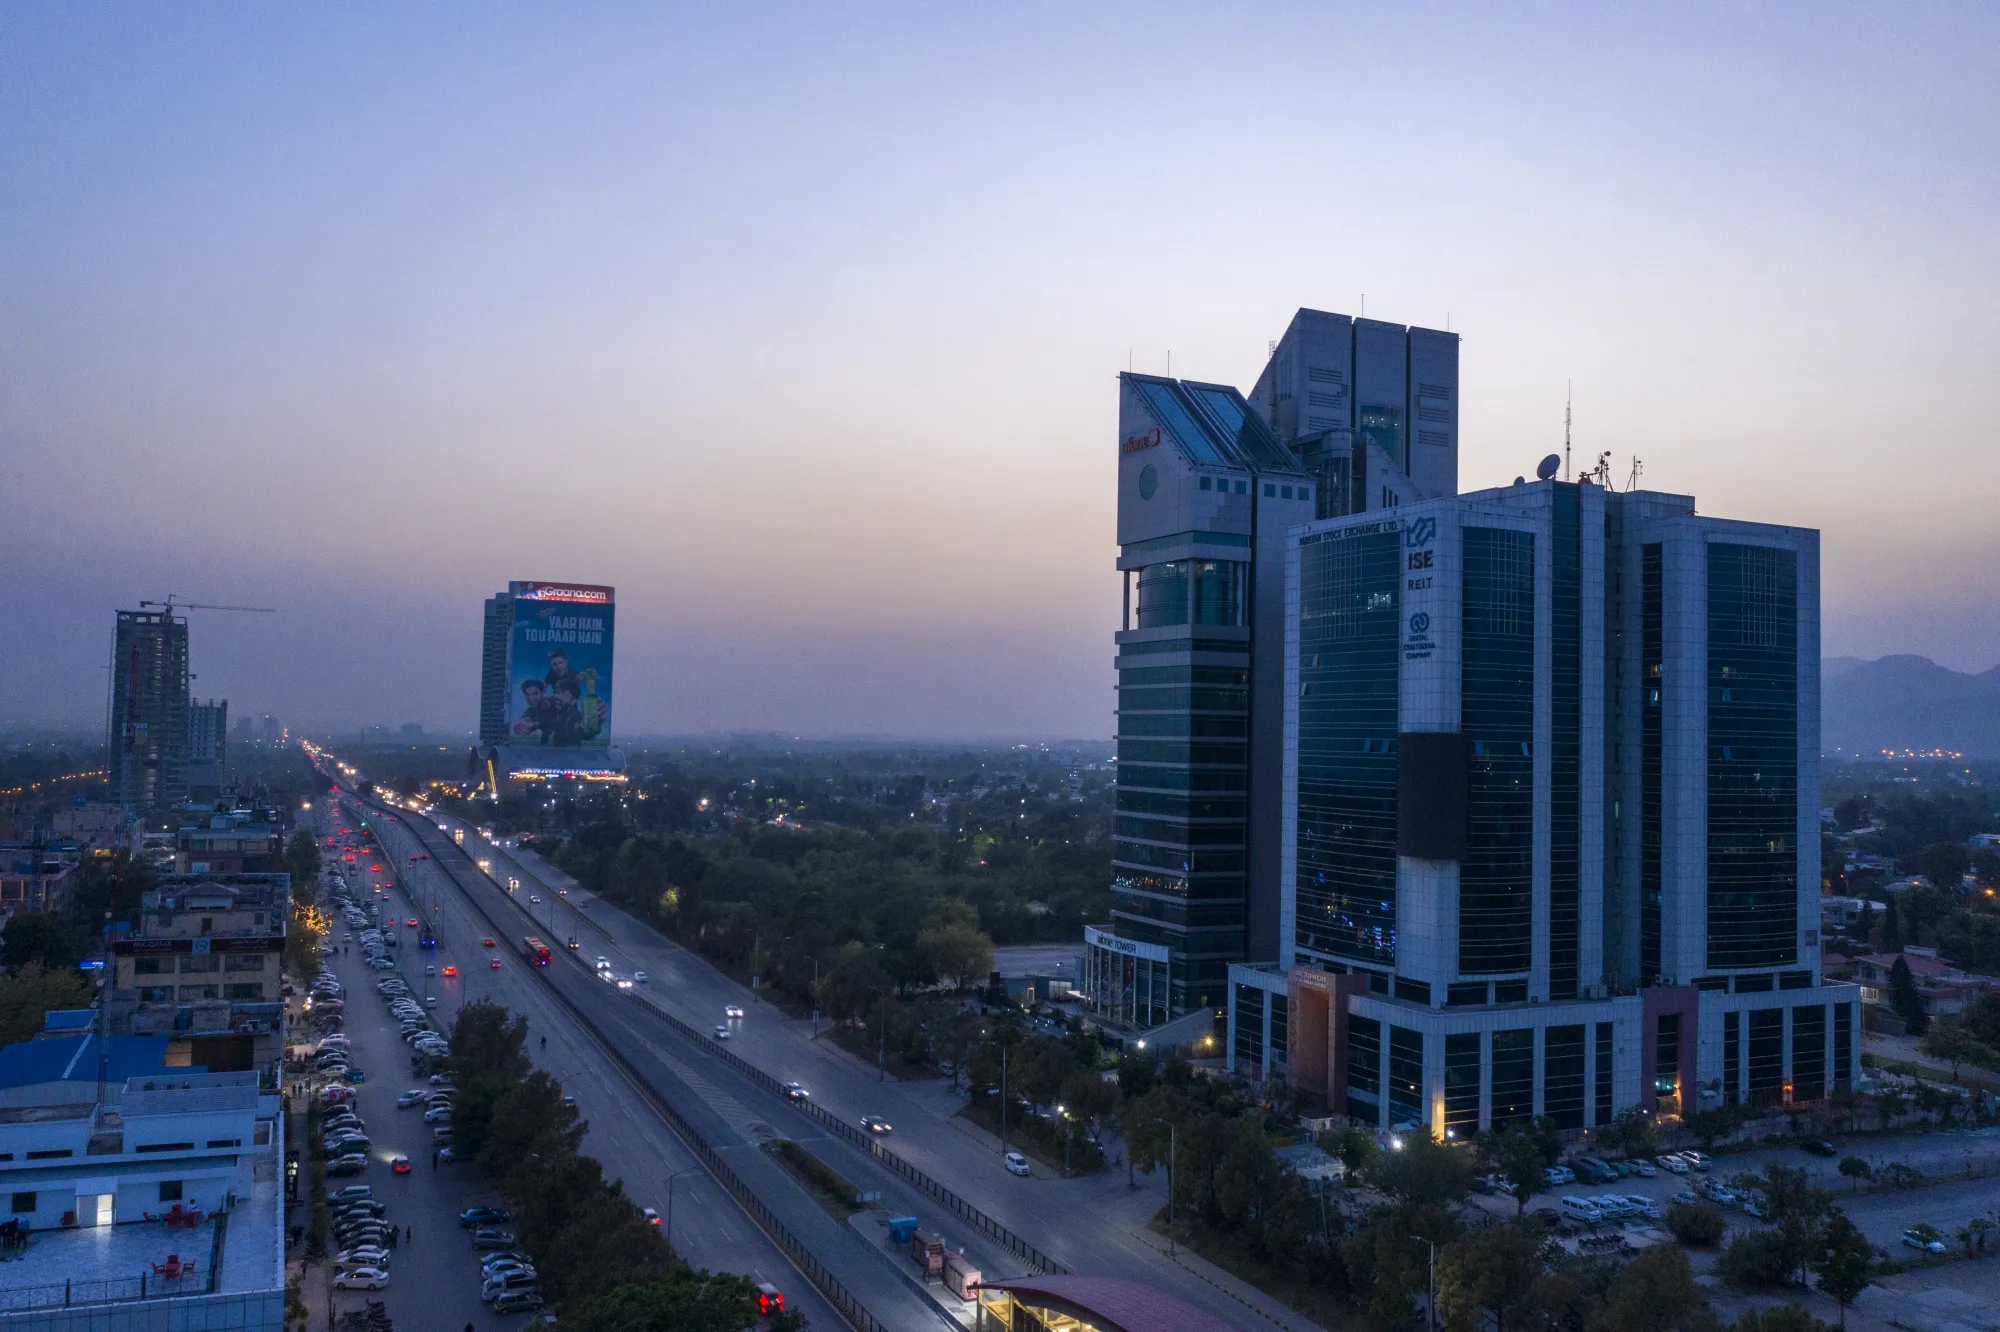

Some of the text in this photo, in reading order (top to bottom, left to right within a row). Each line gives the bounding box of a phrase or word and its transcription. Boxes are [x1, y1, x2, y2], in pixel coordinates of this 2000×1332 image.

[1323, 529, 1342, 541] STOCK
[1345, 523, 1380, 537] EXCHANGE
[1408, 550, 1433, 570] ISE
[1408, 577, 1432, 590] REIT
[544, 586, 606, 600] Graana.com
[548, 616, 576, 629] YAAR
[548, 630, 576, 643] PAAR
[578, 631, 602, 644] HAIN
[1114, 940, 1136, 954] TOWER
